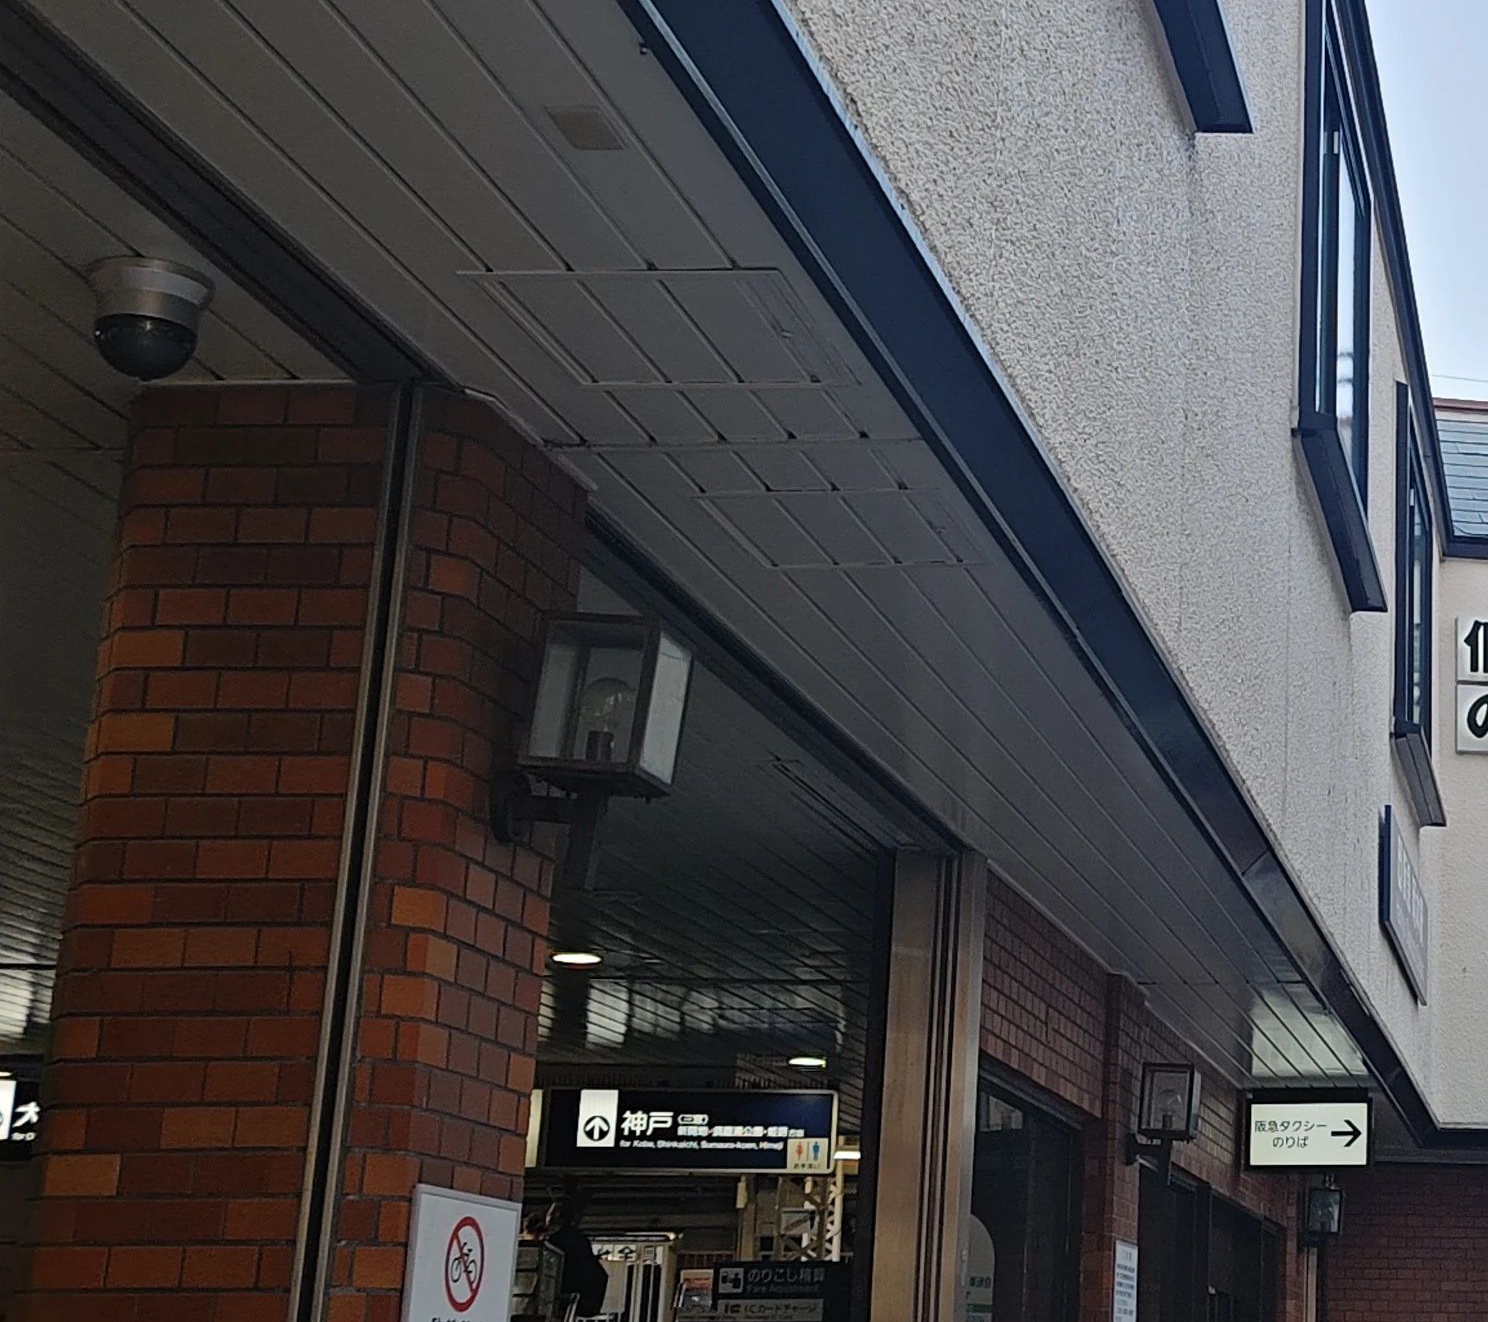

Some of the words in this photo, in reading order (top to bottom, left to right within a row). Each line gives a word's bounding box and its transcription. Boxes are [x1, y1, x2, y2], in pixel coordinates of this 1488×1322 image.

[621, 1110, 675, 1136] 神戸
[1254, 1120, 1328, 1133] 阪急タクシー
[1272, 1136, 1309, 1149] のりば
